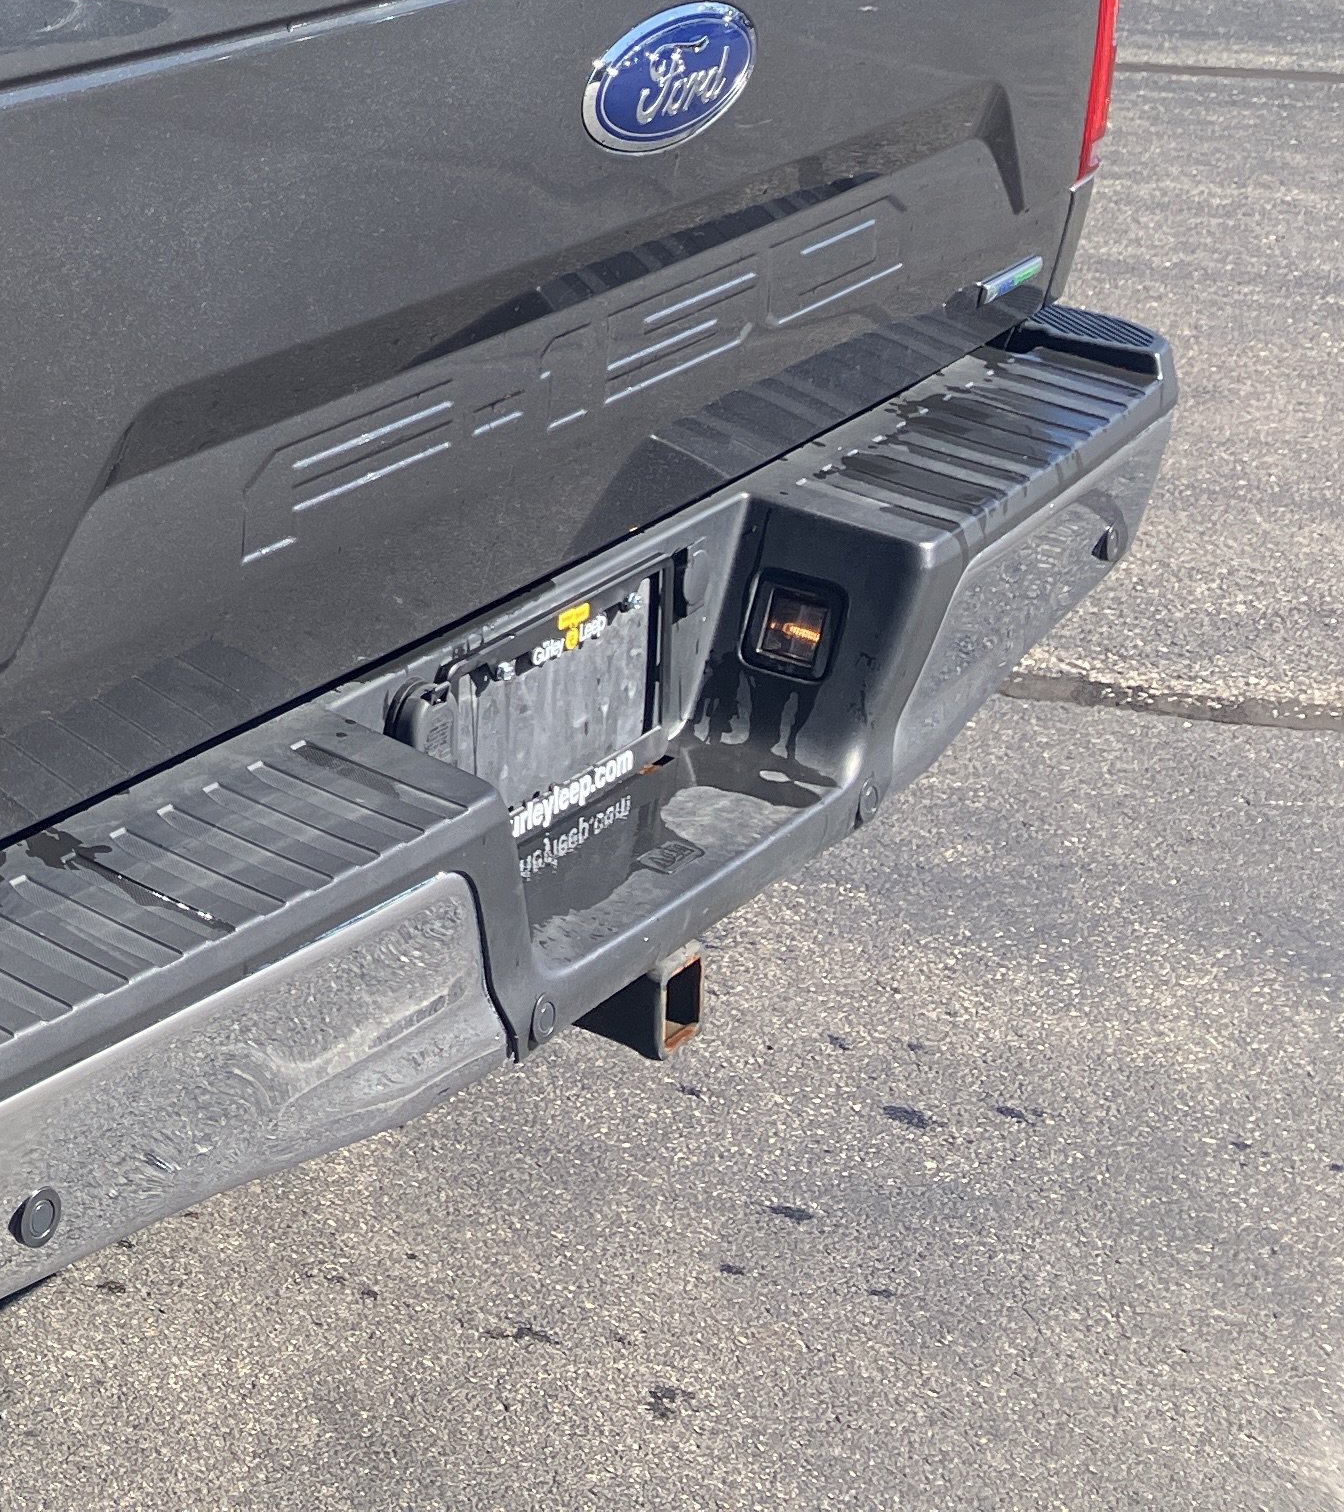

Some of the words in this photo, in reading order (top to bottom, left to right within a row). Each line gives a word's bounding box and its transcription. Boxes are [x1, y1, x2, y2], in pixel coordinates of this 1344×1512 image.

[635, 35, 731, 126] Ford
[241, 193, 910, 565] F-150
[579, 614, 608, 643] Leep
[509, 749, 634, 838] urleyleep.com
